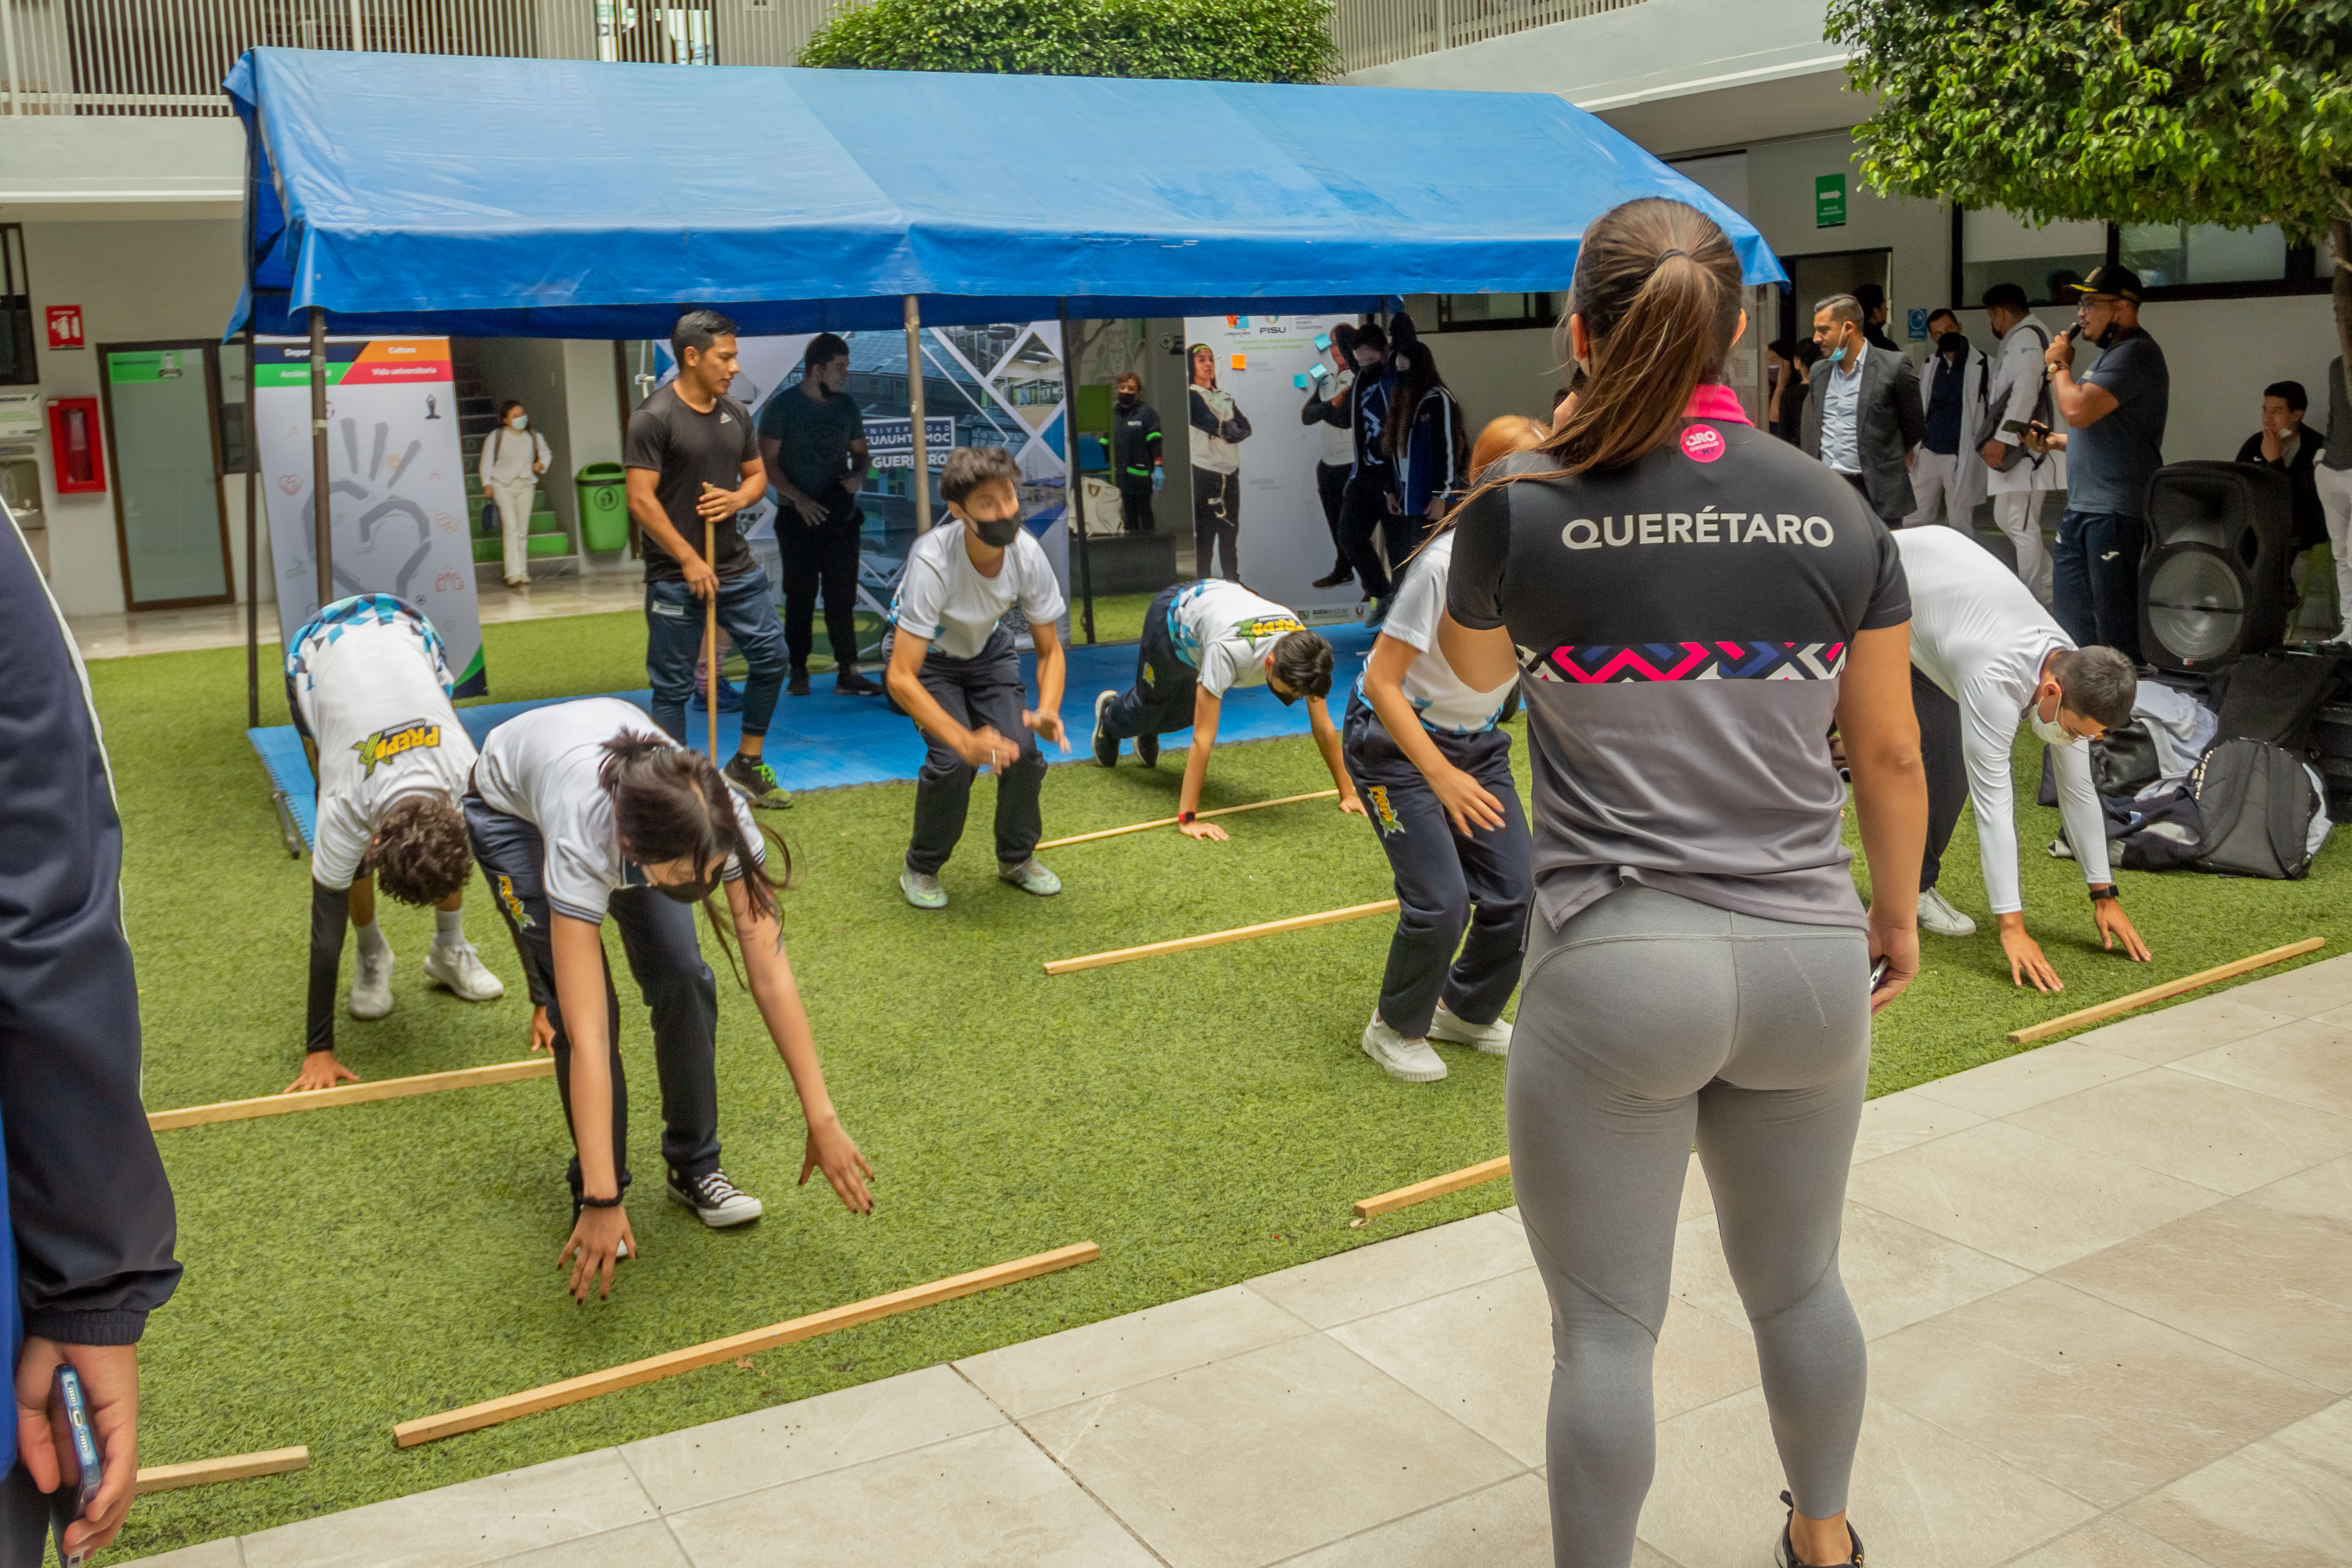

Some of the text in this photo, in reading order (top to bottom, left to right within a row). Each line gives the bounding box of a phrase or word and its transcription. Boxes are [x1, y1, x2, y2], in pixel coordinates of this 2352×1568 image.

[284, 348, 311, 357] Depor
[391, 366, 438, 375] universitaria
[863, 425, 950, 434] NIVERDAD
[866, 433, 950, 445] CUAUHTMOC
[1685, 430, 1717, 446] QRO
[872, 453, 948, 468] GUERRO
[1561, 505, 1834, 550] QUERÉTARO
[374, 726, 439, 760] PREPA
